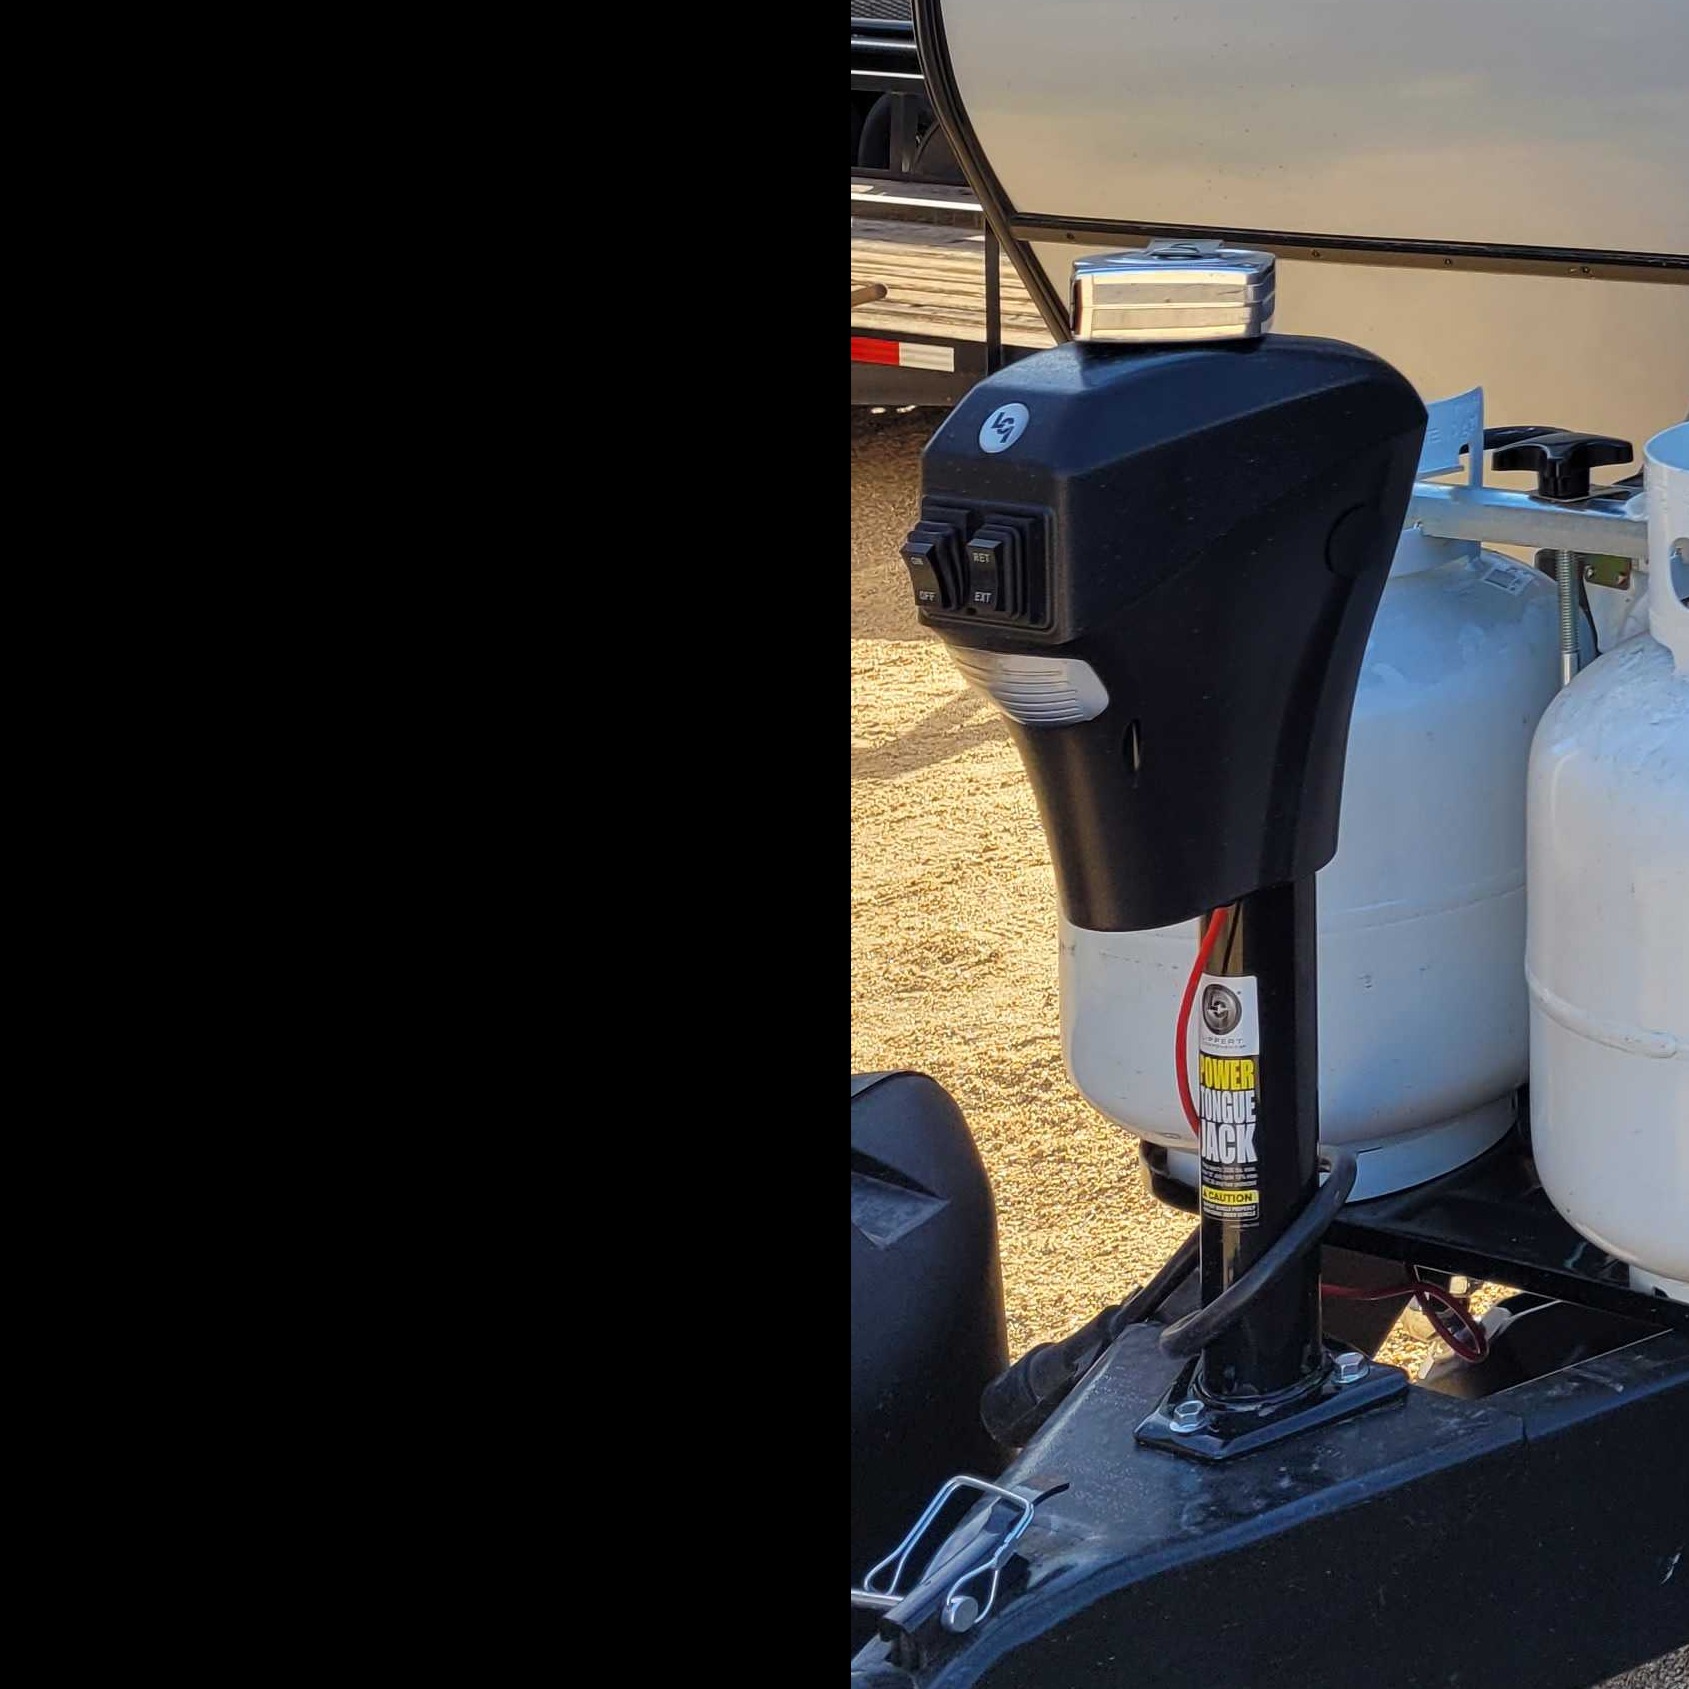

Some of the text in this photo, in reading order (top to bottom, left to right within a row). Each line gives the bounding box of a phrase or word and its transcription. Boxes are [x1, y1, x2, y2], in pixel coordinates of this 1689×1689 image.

[972, 552, 991, 563] RET
[974, 591, 993, 603] EXT
[1200, 1055, 1255, 1090] POWER
[1200, 1085, 1257, 1124] TONGUE
[1200, 1118, 1258, 1164] JACK
[1208, 1191, 1253, 1203] CAUTION
